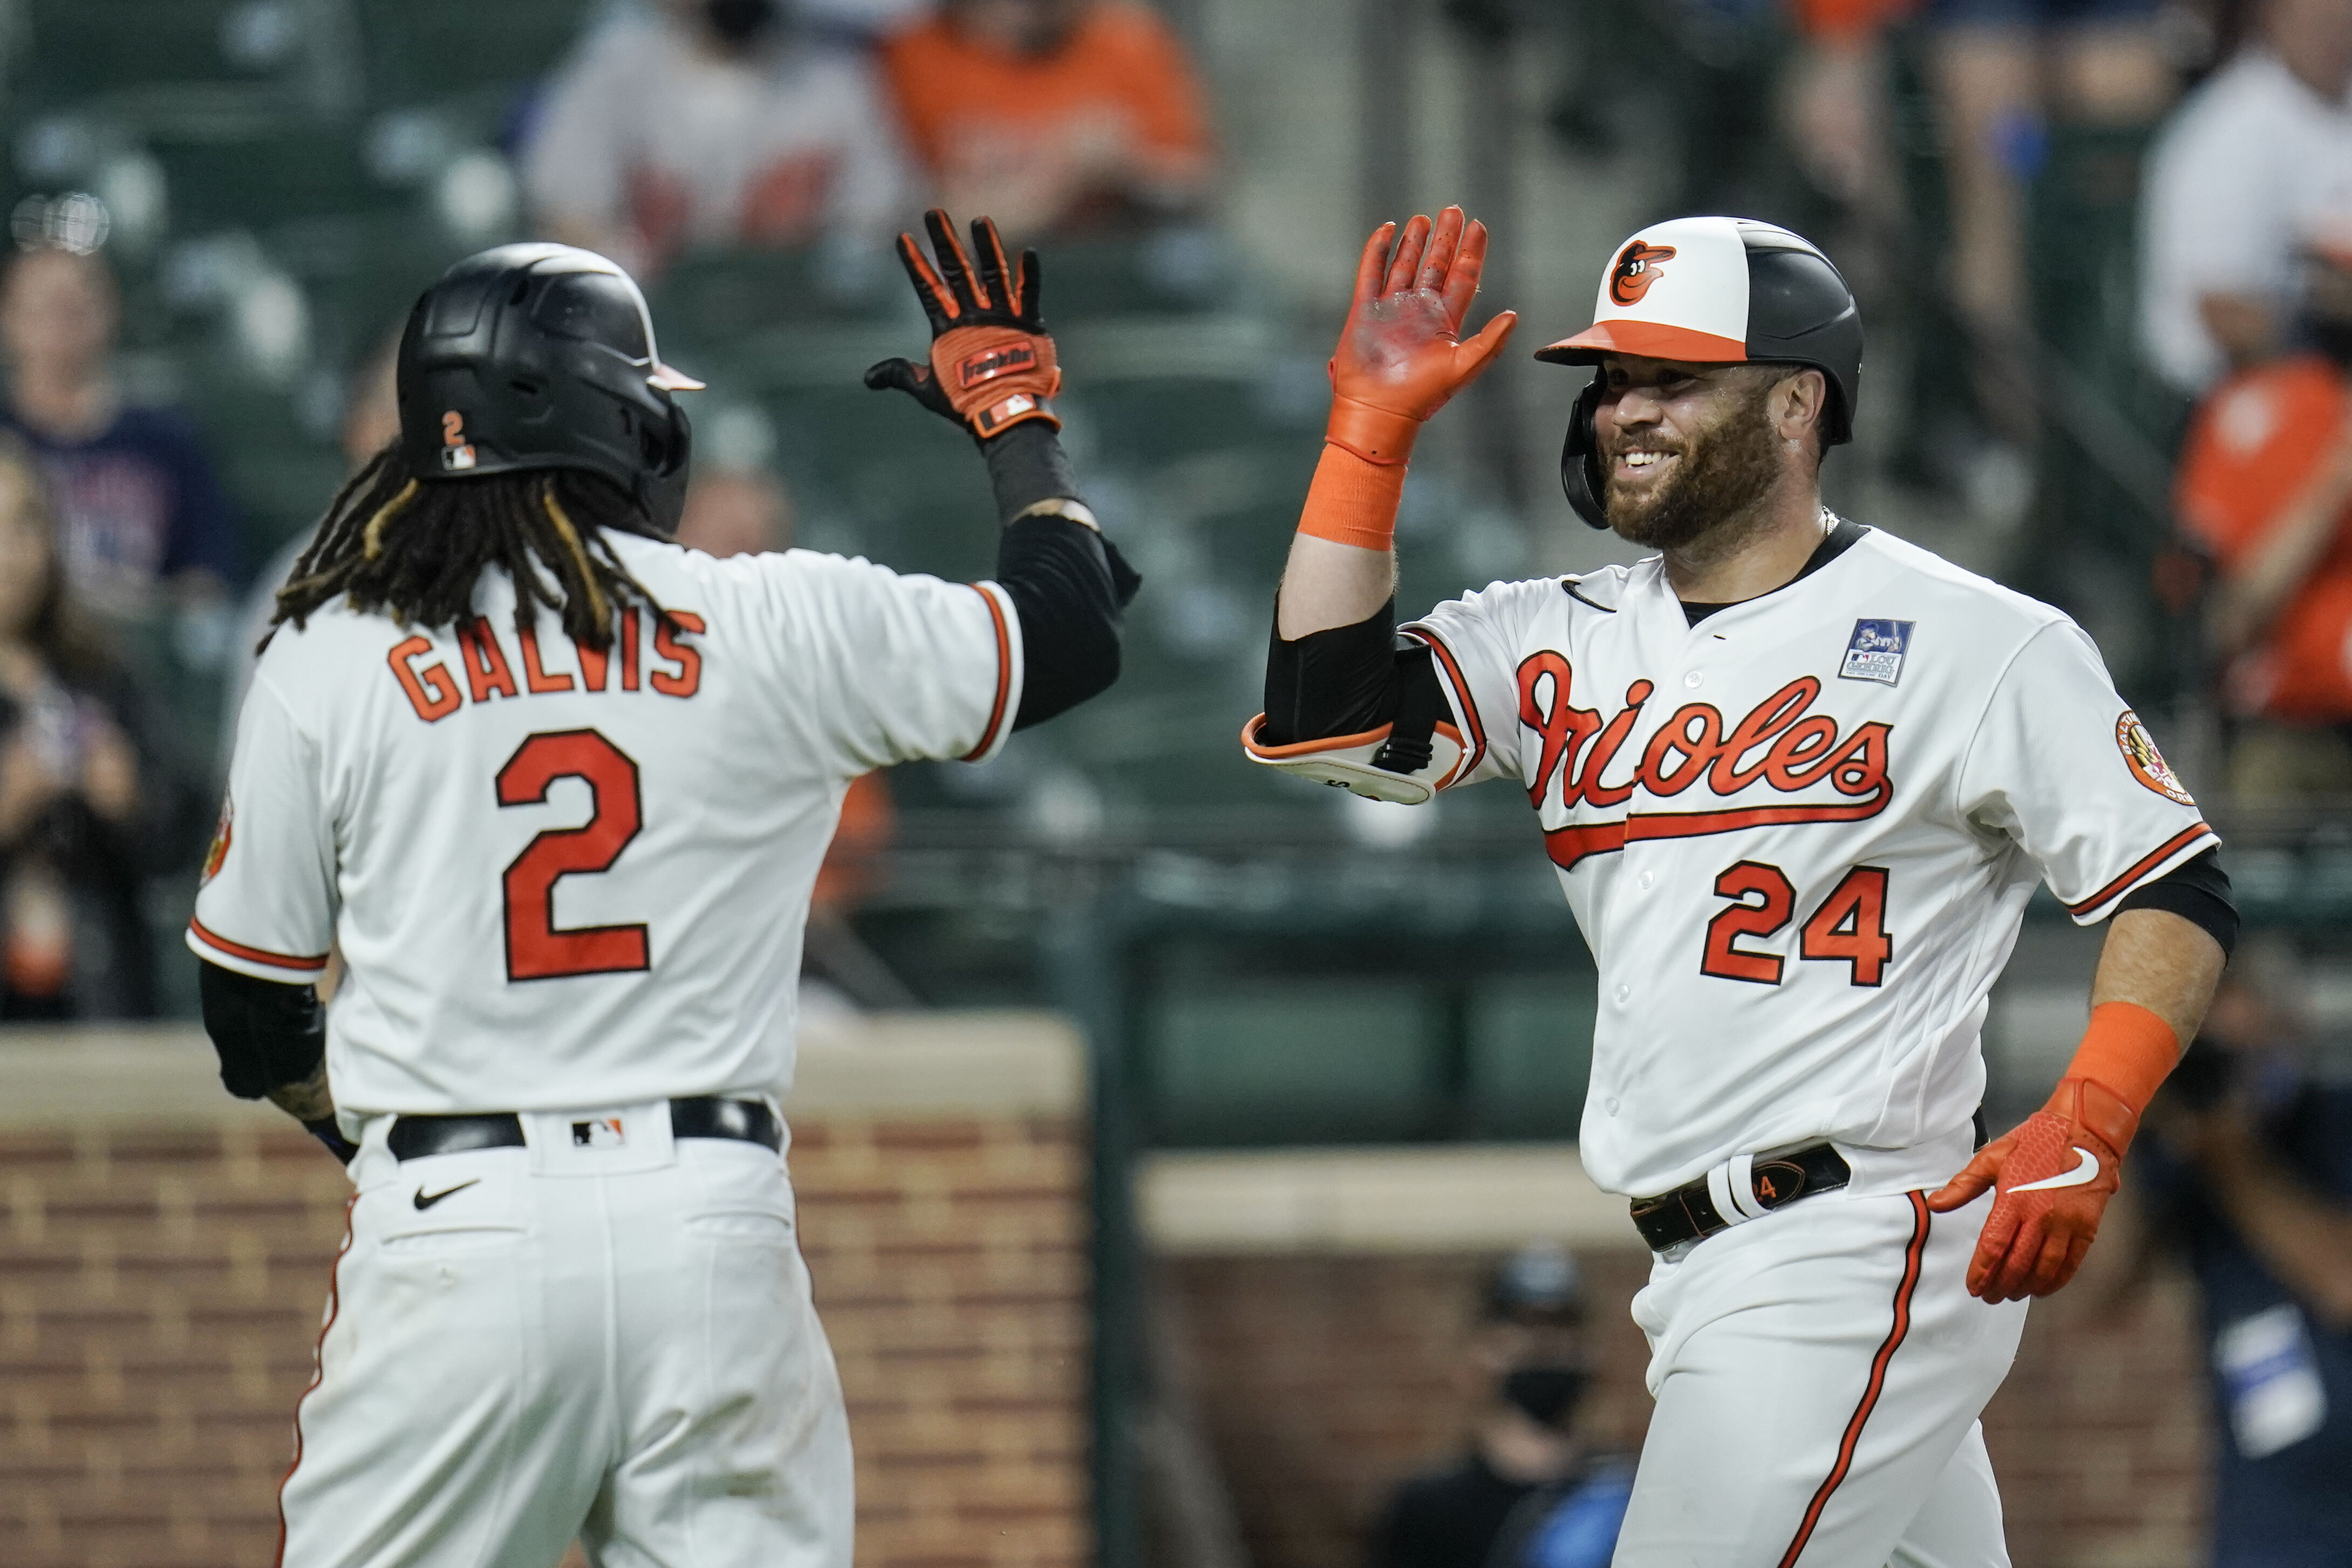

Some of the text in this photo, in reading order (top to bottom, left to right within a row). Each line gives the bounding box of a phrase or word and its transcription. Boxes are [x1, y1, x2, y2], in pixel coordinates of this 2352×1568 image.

[441, 410, 466, 445] 2
[387, 606, 706, 723] GALVIS
[1846, 662, 1895, 674] GEHRIG
[1870, 654, 1897, 665] LOU
[1516, 650, 1894, 813] Orioles
[495, 728, 651, 983] 2
[1700, 860, 1892, 988] 24
